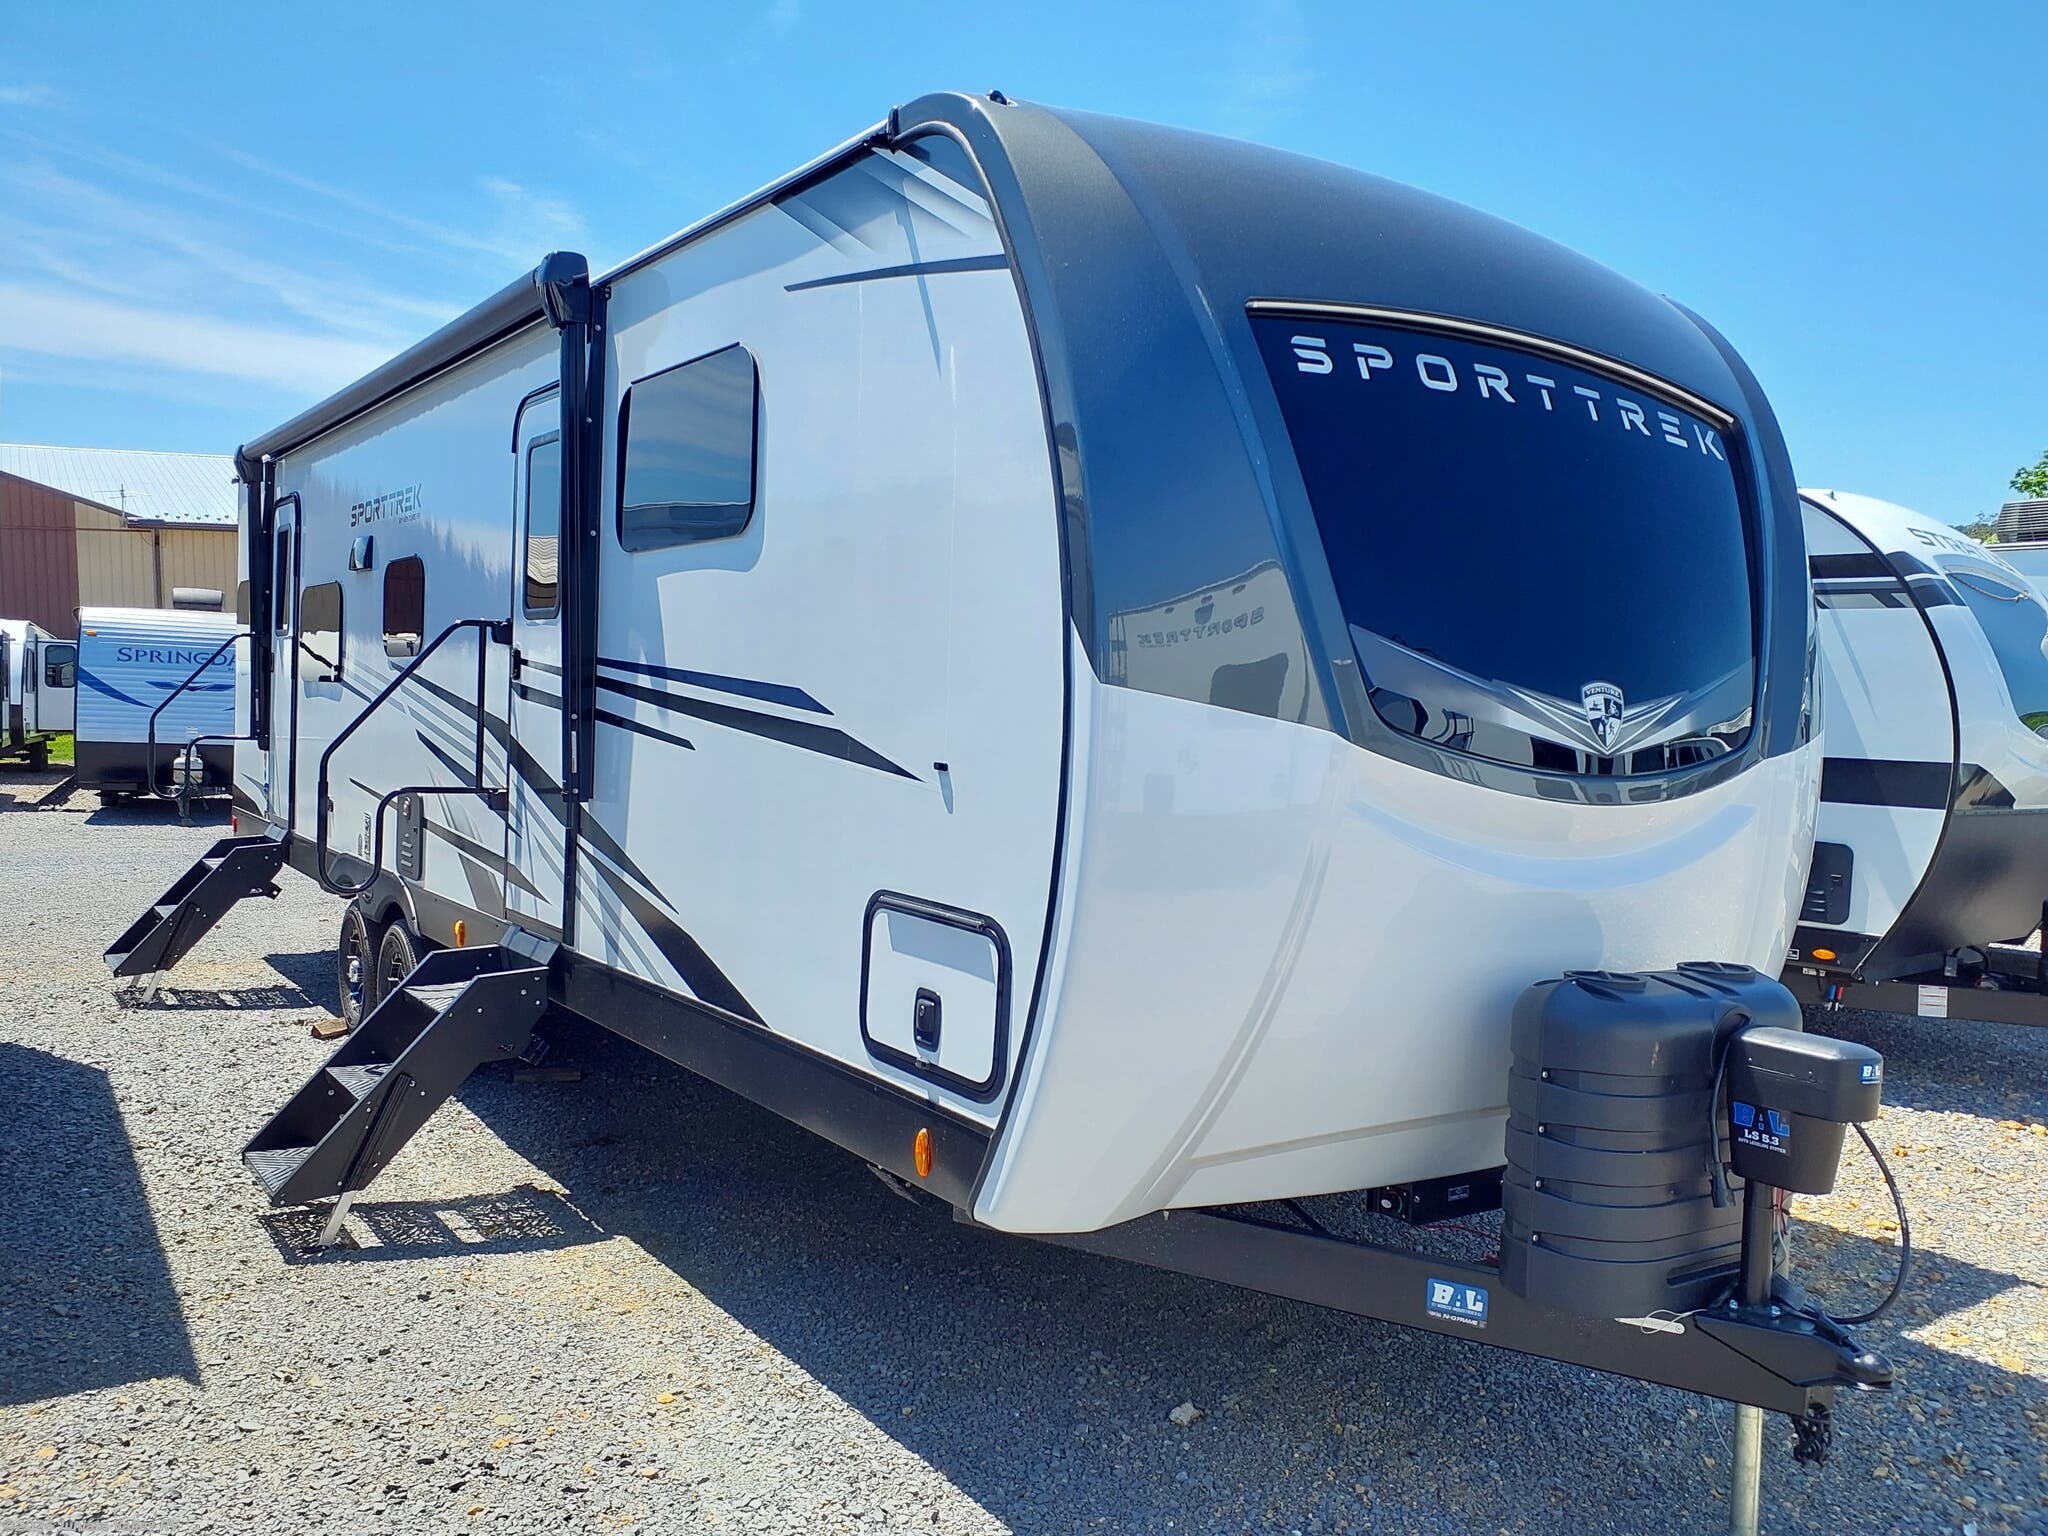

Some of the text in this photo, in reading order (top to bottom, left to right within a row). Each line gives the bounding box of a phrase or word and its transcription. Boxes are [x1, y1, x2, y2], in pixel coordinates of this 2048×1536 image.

[1290, 335, 1725, 461] SPORTTREK
[350, 483, 422, 528] SPORTTREK
[1585, 687, 1620, 698] VENTURE
[1743, 1128, 1780, 1146] LS 5.3
[1432, 1282, 1484, 1313] BAL
